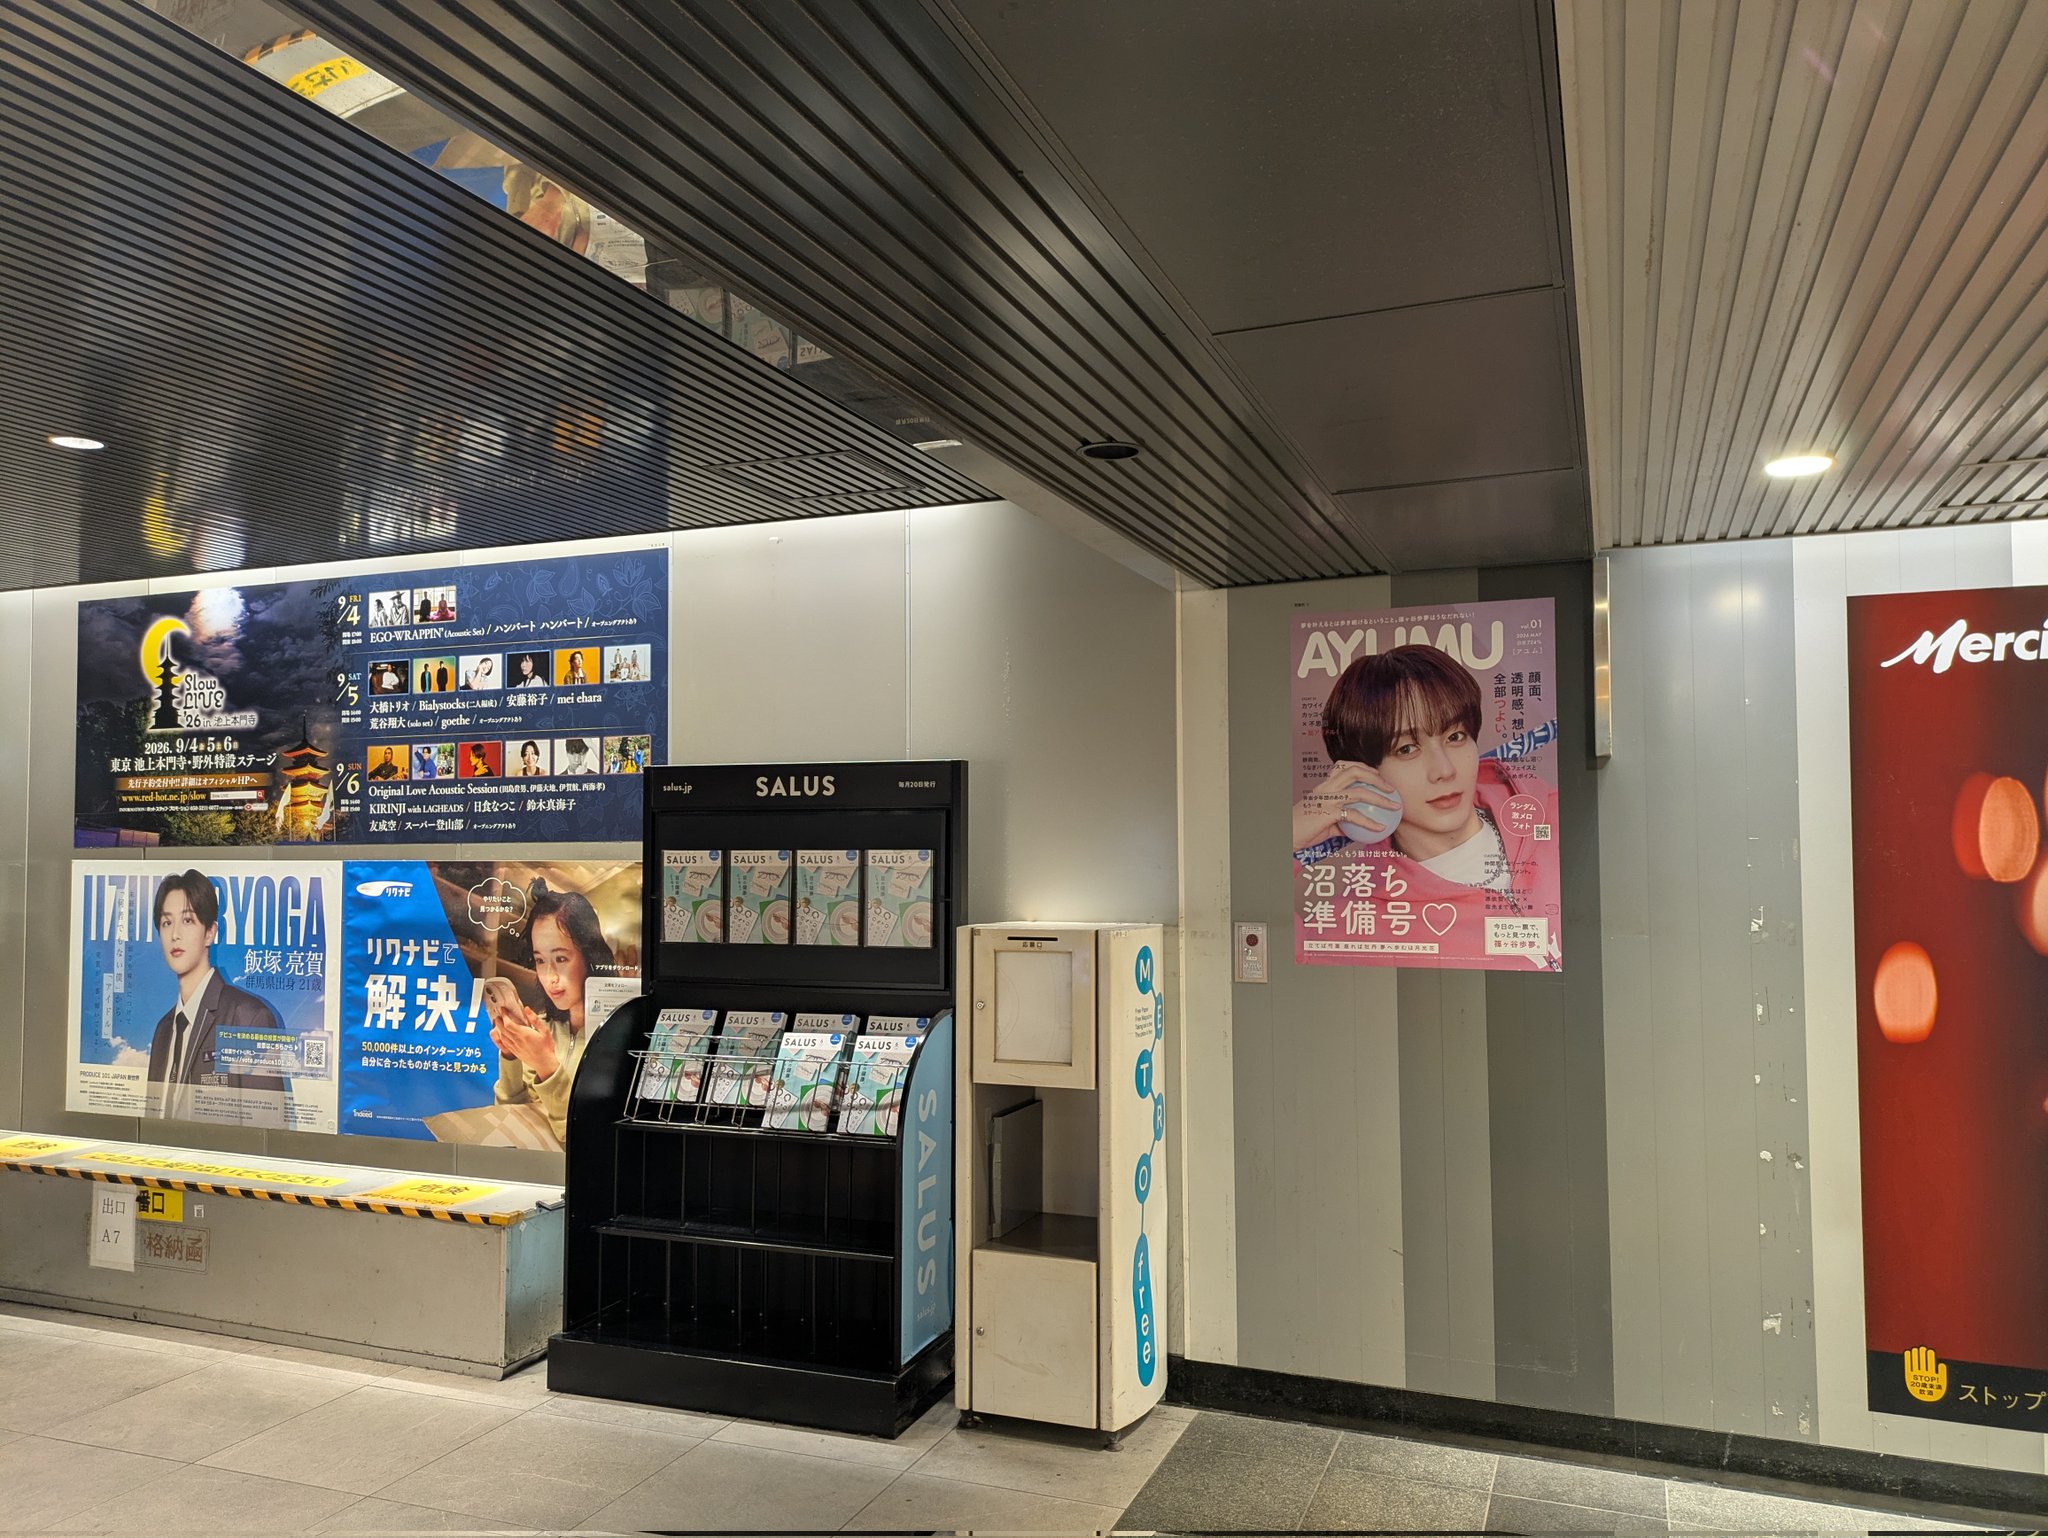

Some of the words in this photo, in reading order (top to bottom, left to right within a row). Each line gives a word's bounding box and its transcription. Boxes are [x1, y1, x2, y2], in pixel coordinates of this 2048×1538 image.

[349, 594, 362, 603] FRI
[494, 620, 536, 634] ハンバート
[540, 617, 583, 630] ハンバート
[184, 673, 217, 692] Slow
[348, 672, 362, 681] SAT
[183, 690, 224, 710] LIVE
[369, 701, 410, 714] 大橋トリオ
[506, 693, 549, 707] 安藤裕子
[557, 693, 574, 705] mei
[576, 691, 602, 704] ehara
[1493, 672, 1508, 739] 全部つよい。
[183, 710, 202, 728] '26
[202, 717, 212, 727] in
[213, 714, 257, 727] 池上本門寺
[369, 717, 406, 730] 荒谷翔大
[441, 714, 471, 730] goethe
[144, 741, 173, 755] 2026.
[110, 756, 132, 773] 東京
[134, 752, 277, 772] 池上本門寺・野外特設ステージ
[347, 762, 362, 772] SUN
[368, 785, 404, 800] Original
[406, 784, 427, 796] Love
[428, 783, 466, 796] Acoustic
[467, 782, 498, 795] Session
[662, 782, 693, 795] salus.jp
[755, 775, 836, 797] SALUS
[898, 779, 937, 789] 毎月20日発行
[121, 790, 207, 804] www.red-hot.ne.jp/slow
[369, 803, 407, 816] KIRINJI
[407, 805, 422, 814] with
[422, 803, 464, 813] LAGHEADS
[474, 799, 516, 812] 日食なつこ
[526, 798, 577, 812] 鈴木真海子
[1510, 801, 1537, 812] ランダム
[1511, 811, 1533, 820] 激メロ
[369, 819, 397, 832] 友成空
[404, 818, 464, 831] スーパー登山部
[1512, 821, 1531, 831] フォト
[666, 855, 698, 865] SALUS
[733, 855, 766, 865] SALUS
[800, 855, 834, 864] SALUS
[871, 855, 906, 864] SALUS
[1302, 863, 1408, 898] 沼落ち
[385, 887, 411, 898] リクナビ
[482, 895, 512, 903] やりたいこと
[1302, 900, 1417, 937] 準備号
[1493, 923, 1540, 931] 今日の一票で、
[1494, 931, 1540, 939] もっと見つかれ
[366, 937, 459, 967] リクナビで
[244, 948, 282, 975] 飯塚
[285, 950, 324, 977] 亮賀
[245, 976, 296, 991] 群馬県出身
[299, 977, 322, 992] 21歳
[363, 974, 486, 1034] 解決!
[660, 1013, 691, 1023] SALUS
[727, 1015, 760, 1025] SALUS
[796, 1018, 830, 1028] SALUS
[869, 1021, 904, 1031] SALUS
[784, 1037, 817, 1047] SALUS
[857, 1040, 893, 1050] SALUS
[361, 1056, 487, 1074] 自分に合ったものがきっと見つかる
[80, 1070, 101, 1079] PRODUCE
[111, 1072, 127, 1080] JAPAN
[916, 1087, 938, 1297] SALUS
[102, 1196, 126, 1216] 出口
[101, 1228, 121, 1244] A7
[1137, 1253, 1152, 1366] free
[1909, 1380, 1943, 1391] 20歳未満
[1912, 1374, 1940, 1384] STOP!
[1958, 1383, 2048, 1411] ストップ
